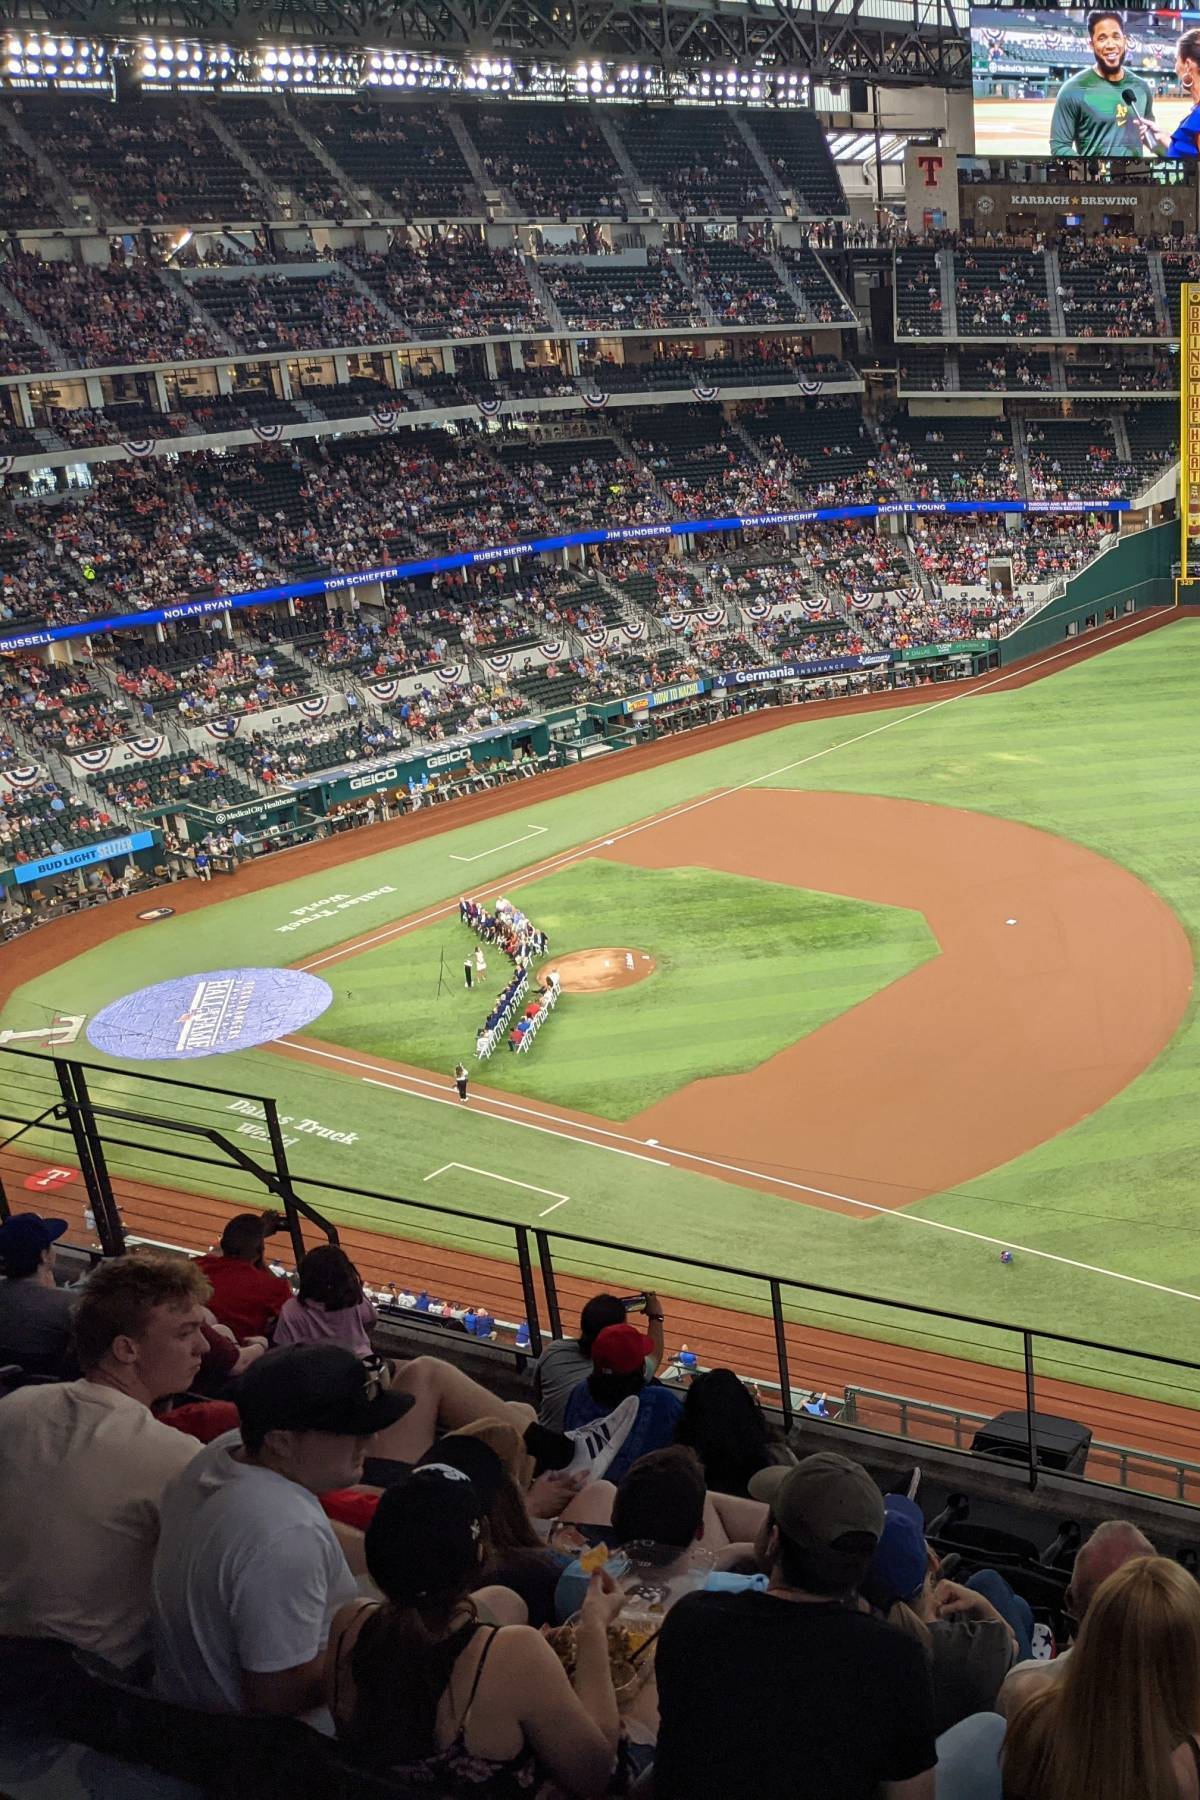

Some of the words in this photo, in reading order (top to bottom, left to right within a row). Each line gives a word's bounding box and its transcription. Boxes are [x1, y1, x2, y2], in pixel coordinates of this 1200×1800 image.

[918, 156, 943, 186] T
[1011, 196, 1070, 206] KARBACH
[1081, 196, 1138, 206] BREWING
[1190, 306, 1200, 378] BRING
[1190, 383, 1200, 422] THE
[1190, 428, 1200, 482] HEAT
[741, 518, 758, 526] TOM
[760, 513, 818, 524] VANDERGRIFF
[878, 505, 914, 513] MICHAEL
[606, 531, 620, 539] JIM
[622, 527, 672, 538] SUNDBERG
[474, 551, 502, 562] RUBEN
[504, 545, 532, 556] SIERRA
[324, 580, 344, 589] TOM
[347, 569, 398, 585] SCHIEFFER
[164, 604, 202, 619] NOLAN
[204, 600, 232, 612] RYAN
[0, 633, 55, 650] RUSSELL
[736, 666, 795, 683] Germania
[797, 664, 845, 675] INSURANCE
[654, 692, 668, 704] HOW
[670, 688, 678, 700] TO
[679, 682, 698, 698] NACHO
[426, 748, 472, 769] GEICO
[350, 768, 398, 790] GEICO
[226, 808, 250, 820] Medical
[251, 804, 264, 815] City
[264, 796, 297, 812] Healthcare
[38, 860, 62, 874] BUD
[64, 850, 97, 866] LIGHT
[98, 838, 133, 858] SELTZER
[290, 894, 351, 916] World
[336, 886, 398, 909] Dallas
[274, 910, 340, 932] Truck
[202, 980, 231, 1008] HALL
[186, 1016, 218, 1050] FAME
[294, 1118, 360, 1145] Truck
[36, 1168, 71, 1186] T
